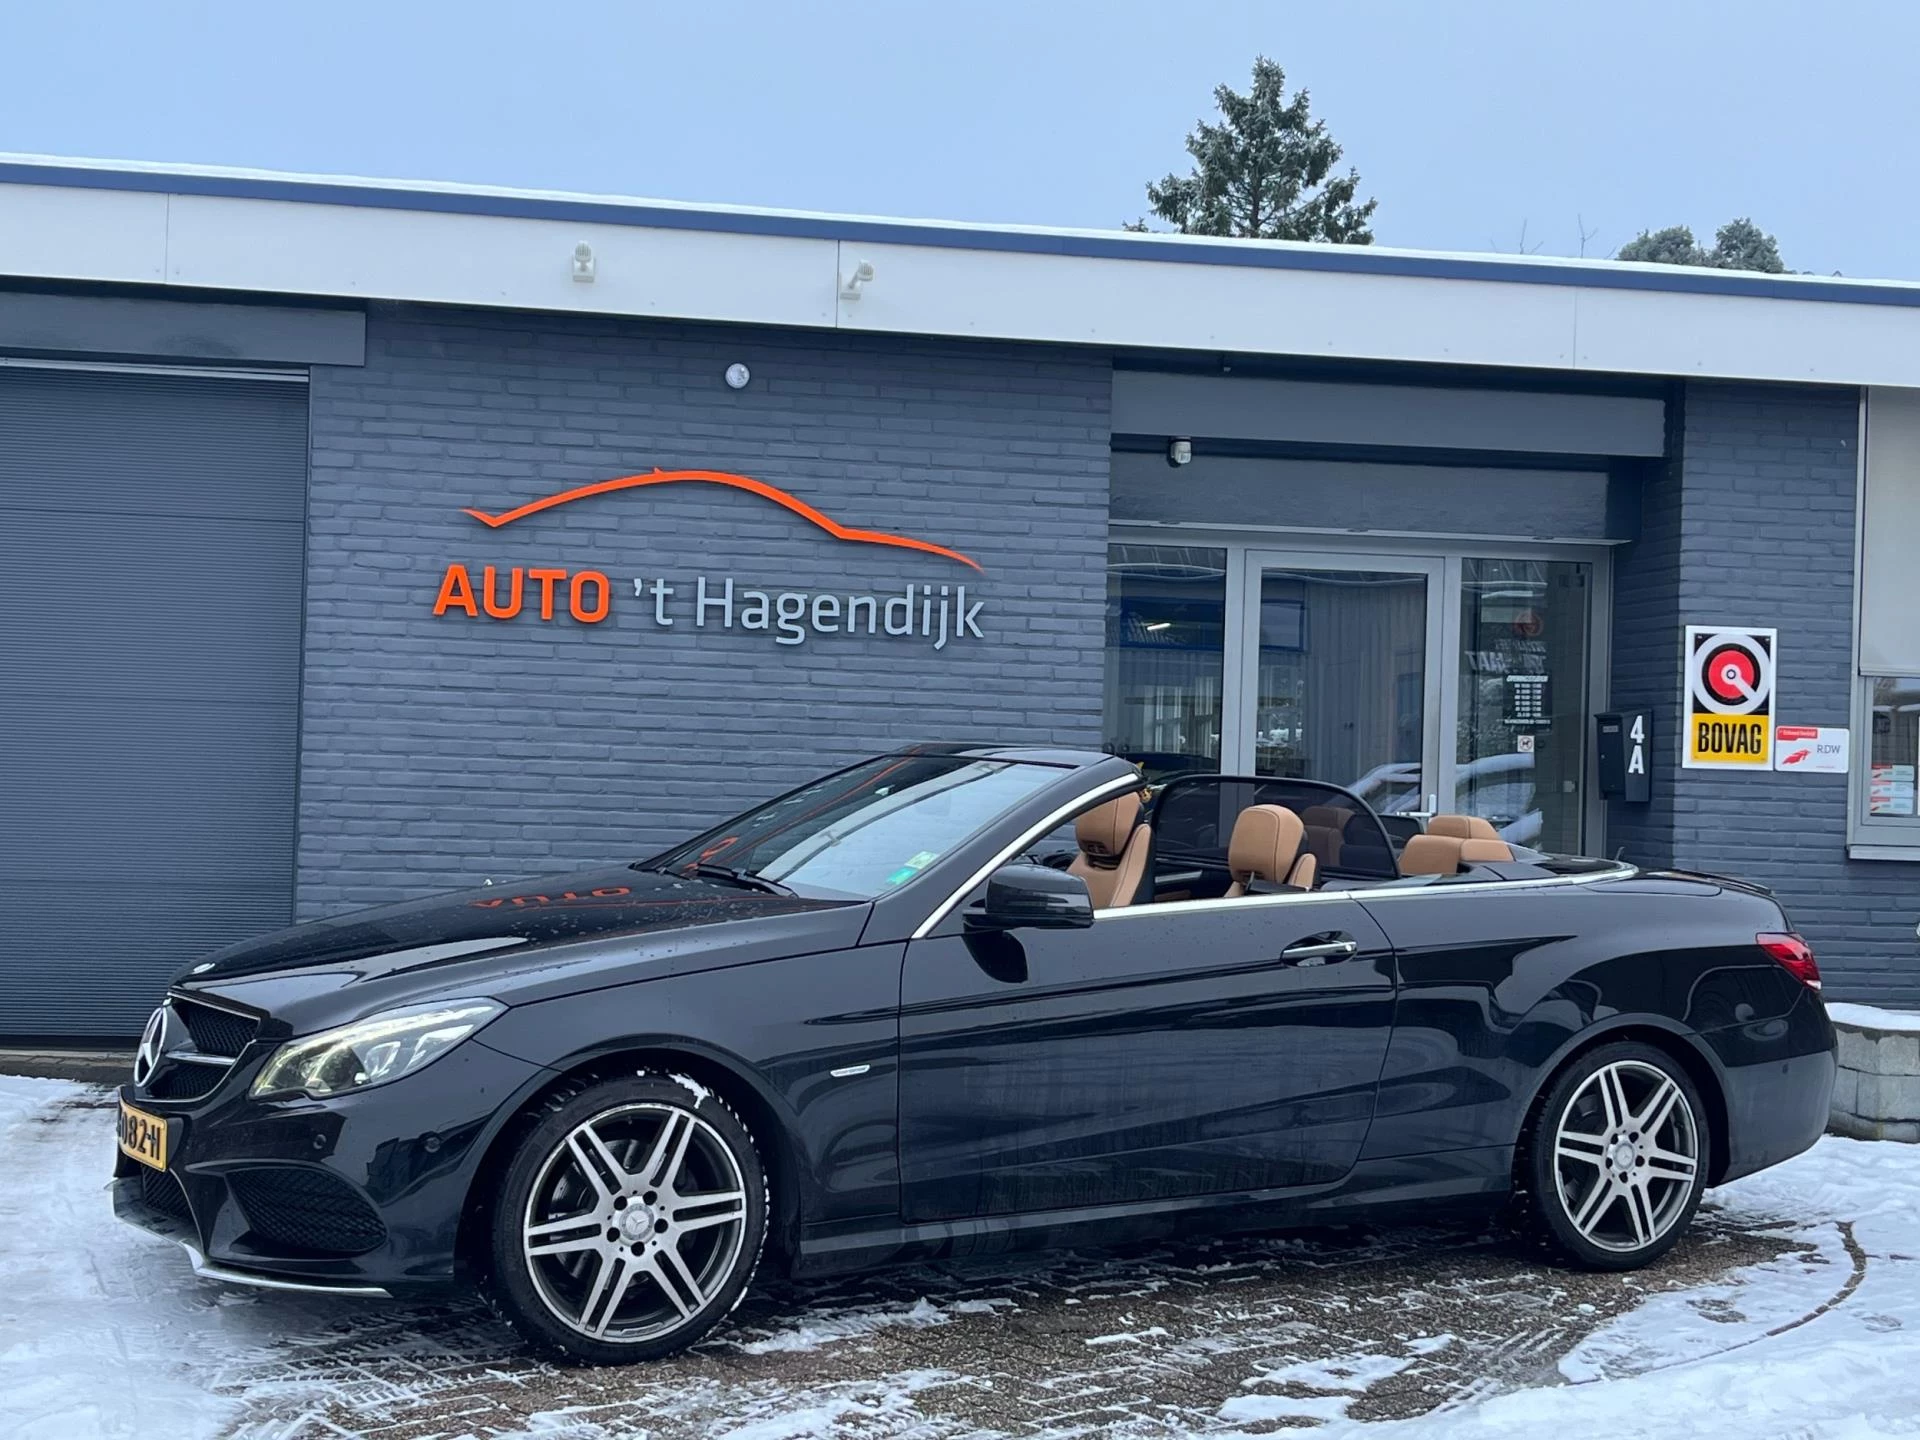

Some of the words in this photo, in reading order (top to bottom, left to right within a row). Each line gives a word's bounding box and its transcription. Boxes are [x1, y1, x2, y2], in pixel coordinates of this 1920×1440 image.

[433, 564, 610, 623] AUTO
[696, 576, 985, 650] Hagendijk
[1630, 715, 1645, 743] 4
[1698, 722, 1762, 754] BOVAG
[1628, 745, 1645, 774] A
[1816, 744, 1841, 754] RDW
